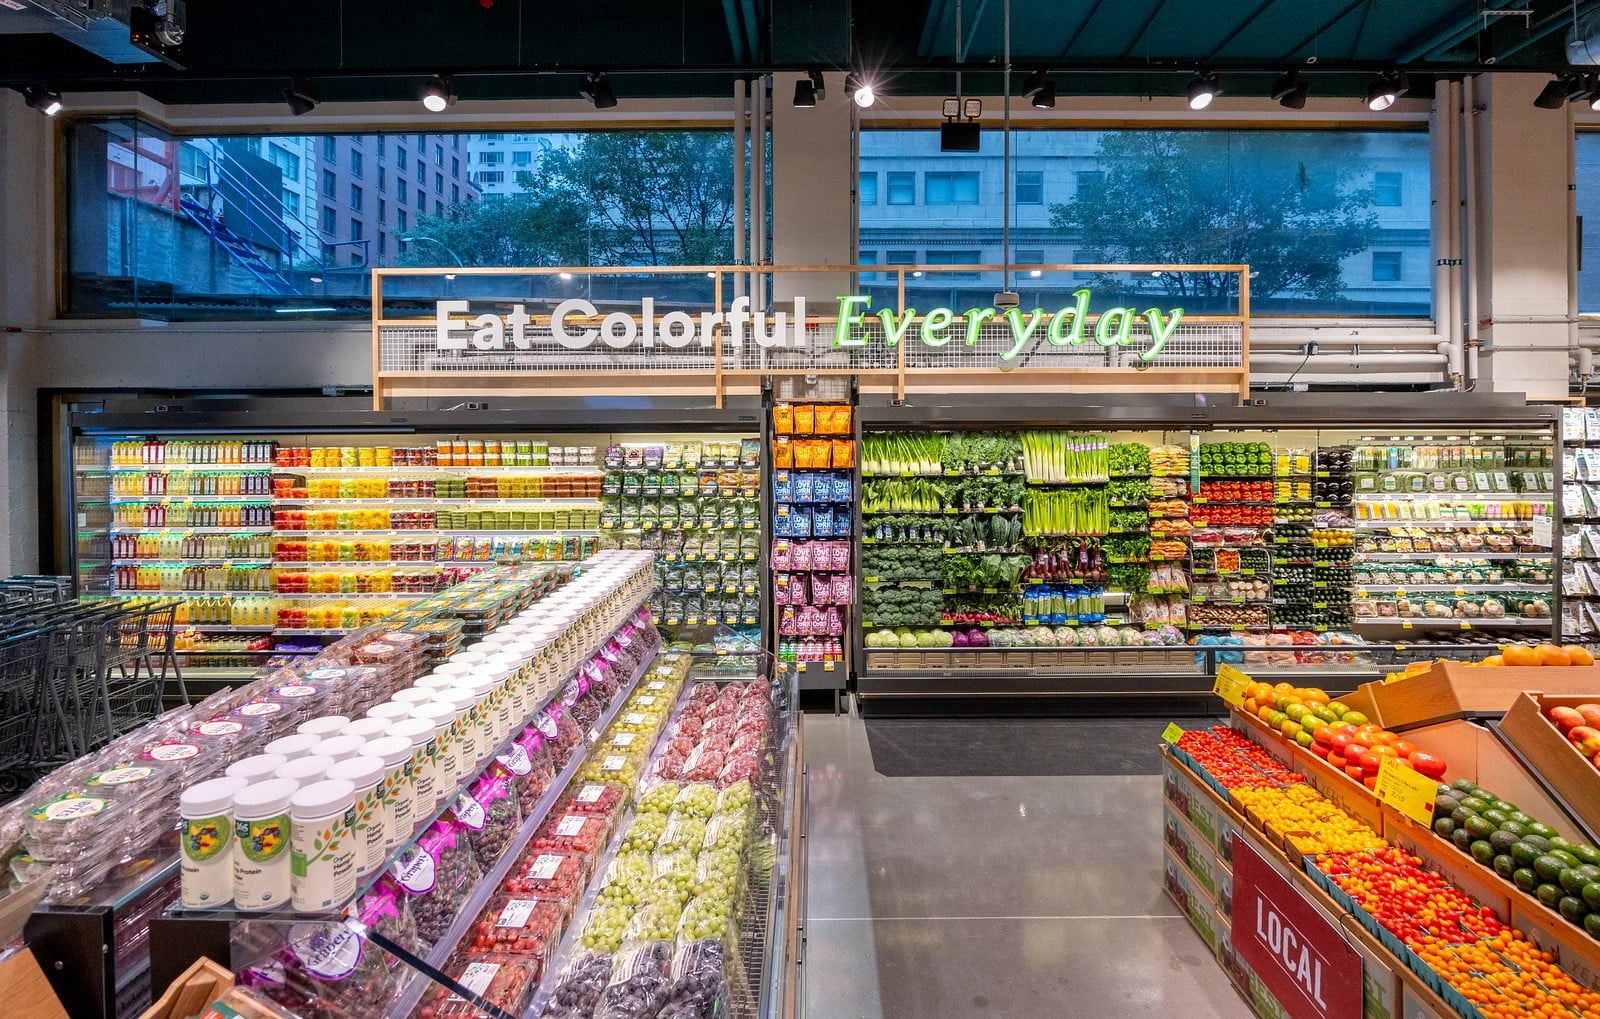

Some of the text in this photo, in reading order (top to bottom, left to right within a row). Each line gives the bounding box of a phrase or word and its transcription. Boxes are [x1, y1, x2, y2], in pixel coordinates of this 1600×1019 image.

[437, 289, 1184, 366] Eat Colorful Everyday
[401, 855, 427, 881] Grapery
[308, 930, 352, 966] Grapery
[1257, 896, 1327, 1011] LOCAL
